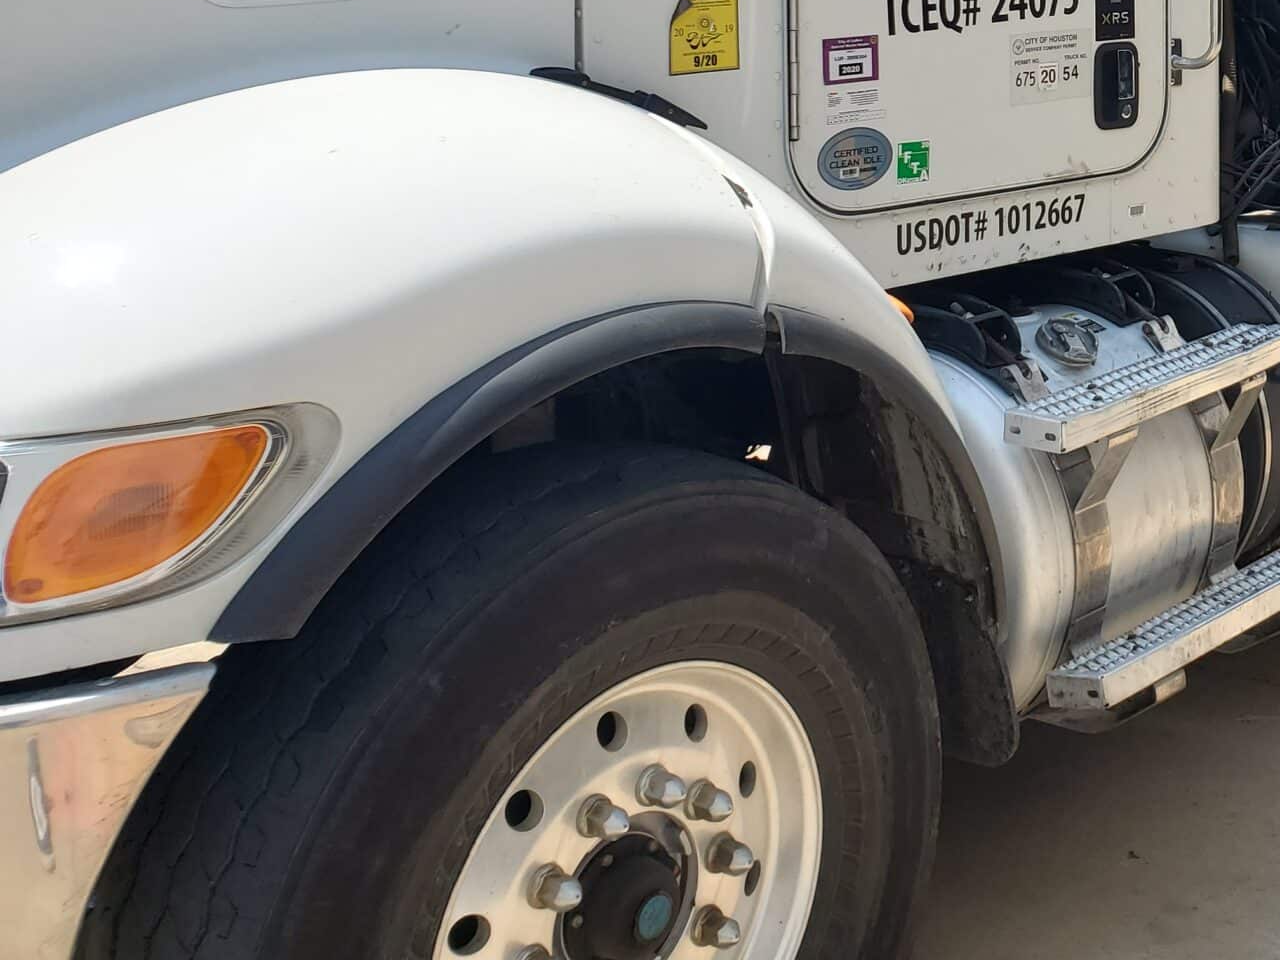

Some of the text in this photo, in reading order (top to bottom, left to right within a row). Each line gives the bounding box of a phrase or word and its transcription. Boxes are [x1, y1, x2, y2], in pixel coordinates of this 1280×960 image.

[1101, 11, 1129, 25] XRS
[725, 23, 734, 33] 19
[1049, 34, 1077, 43] HOUSTON
[693, 54, 718, 67] 9/20
[840, 64, 861, 75] 2020
[1041, 68, 1056, 84] 20
[1063, 64, 1079, 81] 54
[1015, 70, 1036, 87] 675
[834, 145, 879, 159] CERTIFIED
[829, 159, 860, 169] CLEAN
[863, 154, 882, 165] IDLE
[896, 193, 1085, 255] USDOT# 1012667
